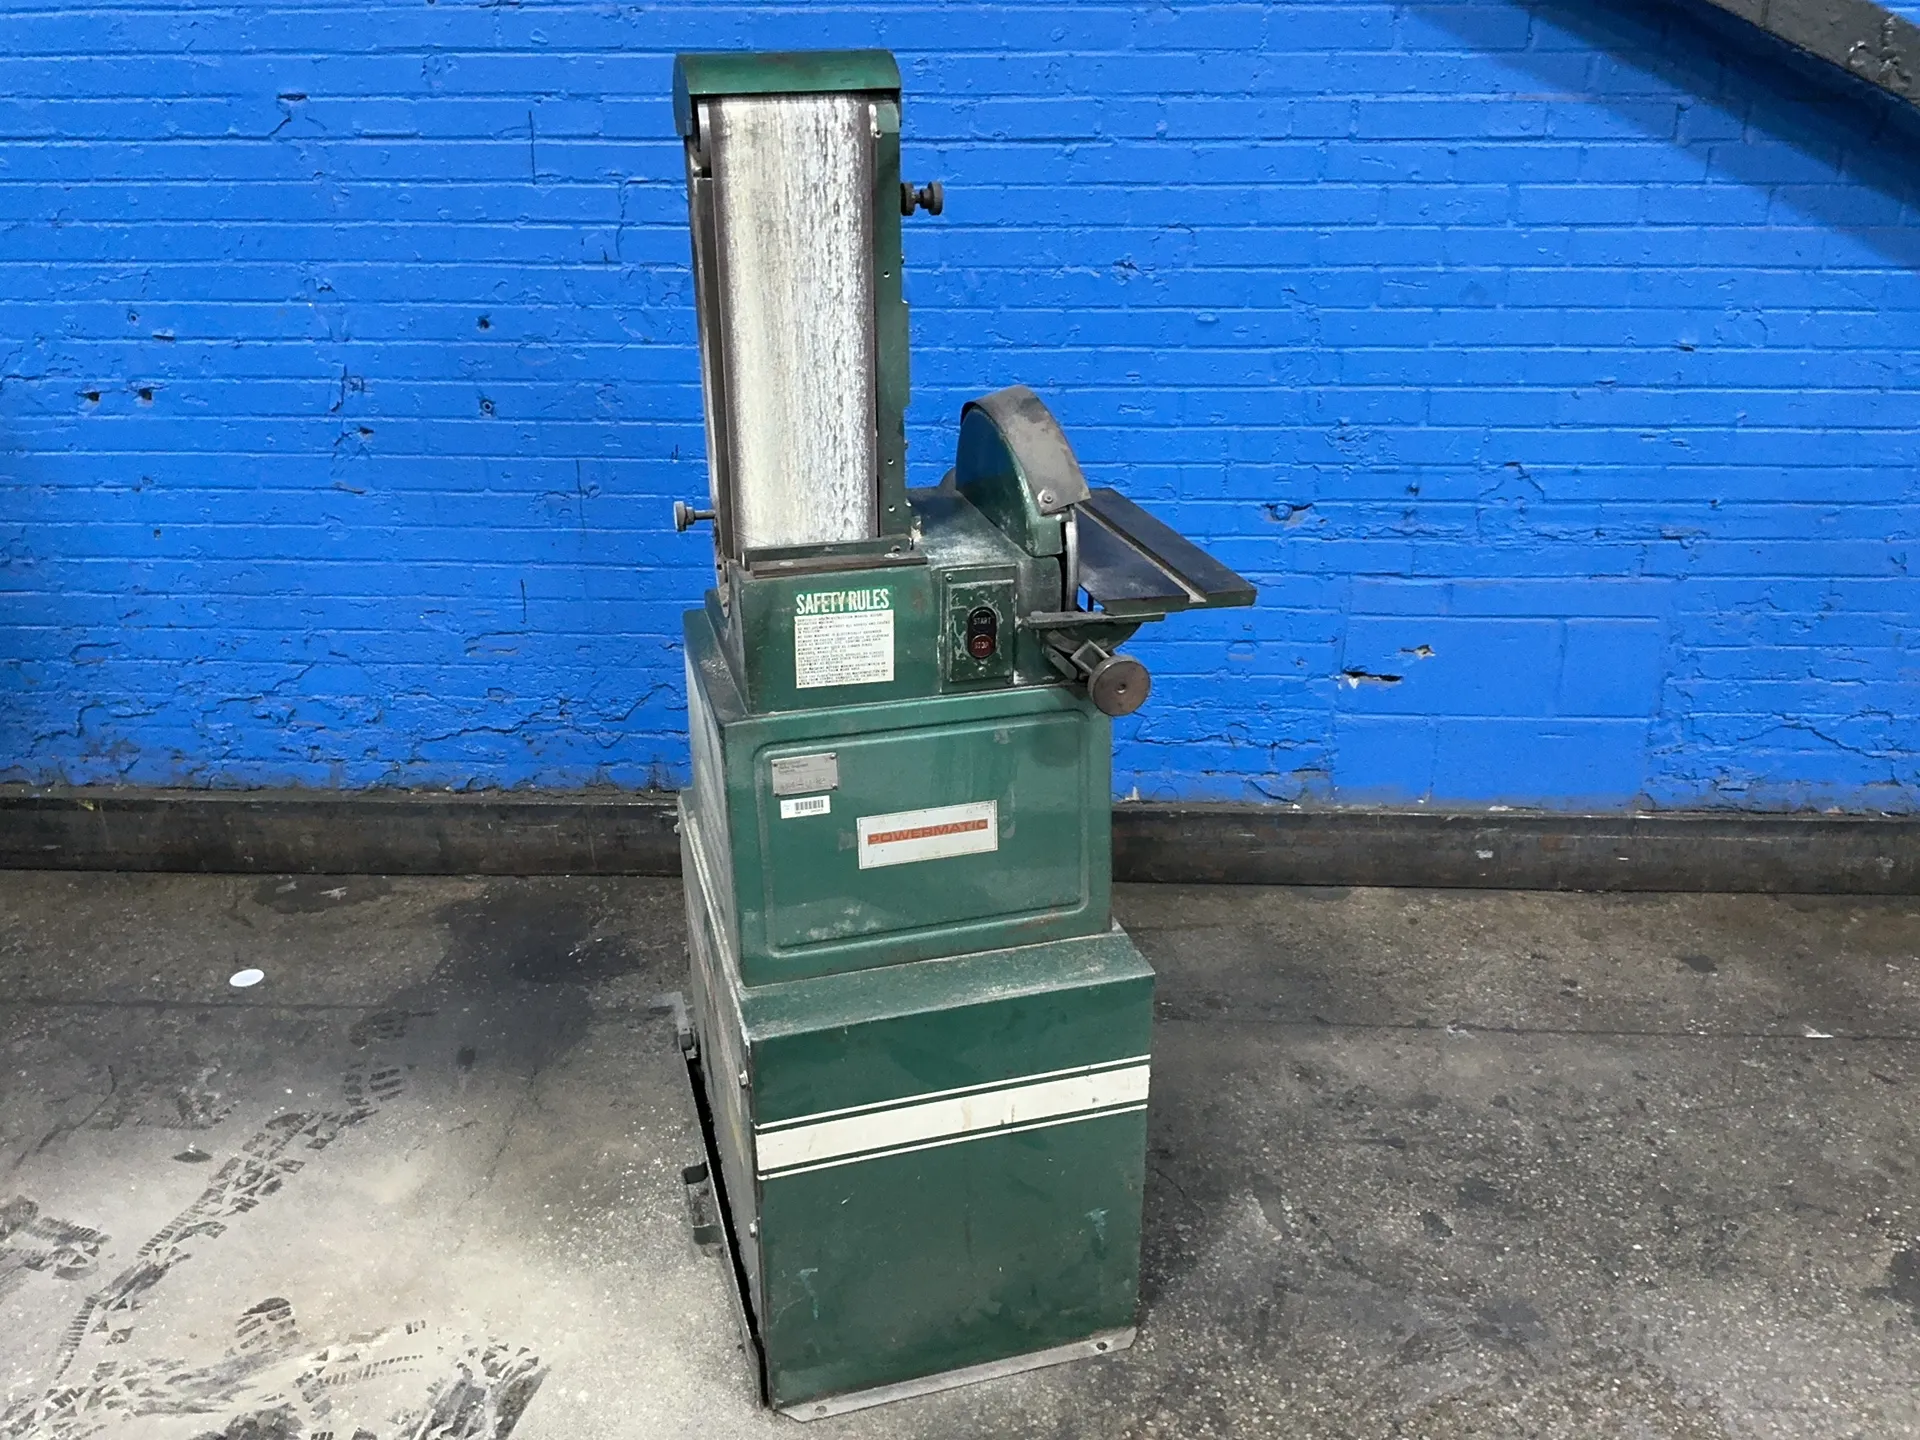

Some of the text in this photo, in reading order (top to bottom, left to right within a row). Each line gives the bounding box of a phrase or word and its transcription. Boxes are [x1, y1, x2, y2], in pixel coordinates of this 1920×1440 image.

[796, 588, 890, 614] SAFETY RULES
[973, 617, 992, 625] START
[868, 818, 988, 845] POWERMATIC
